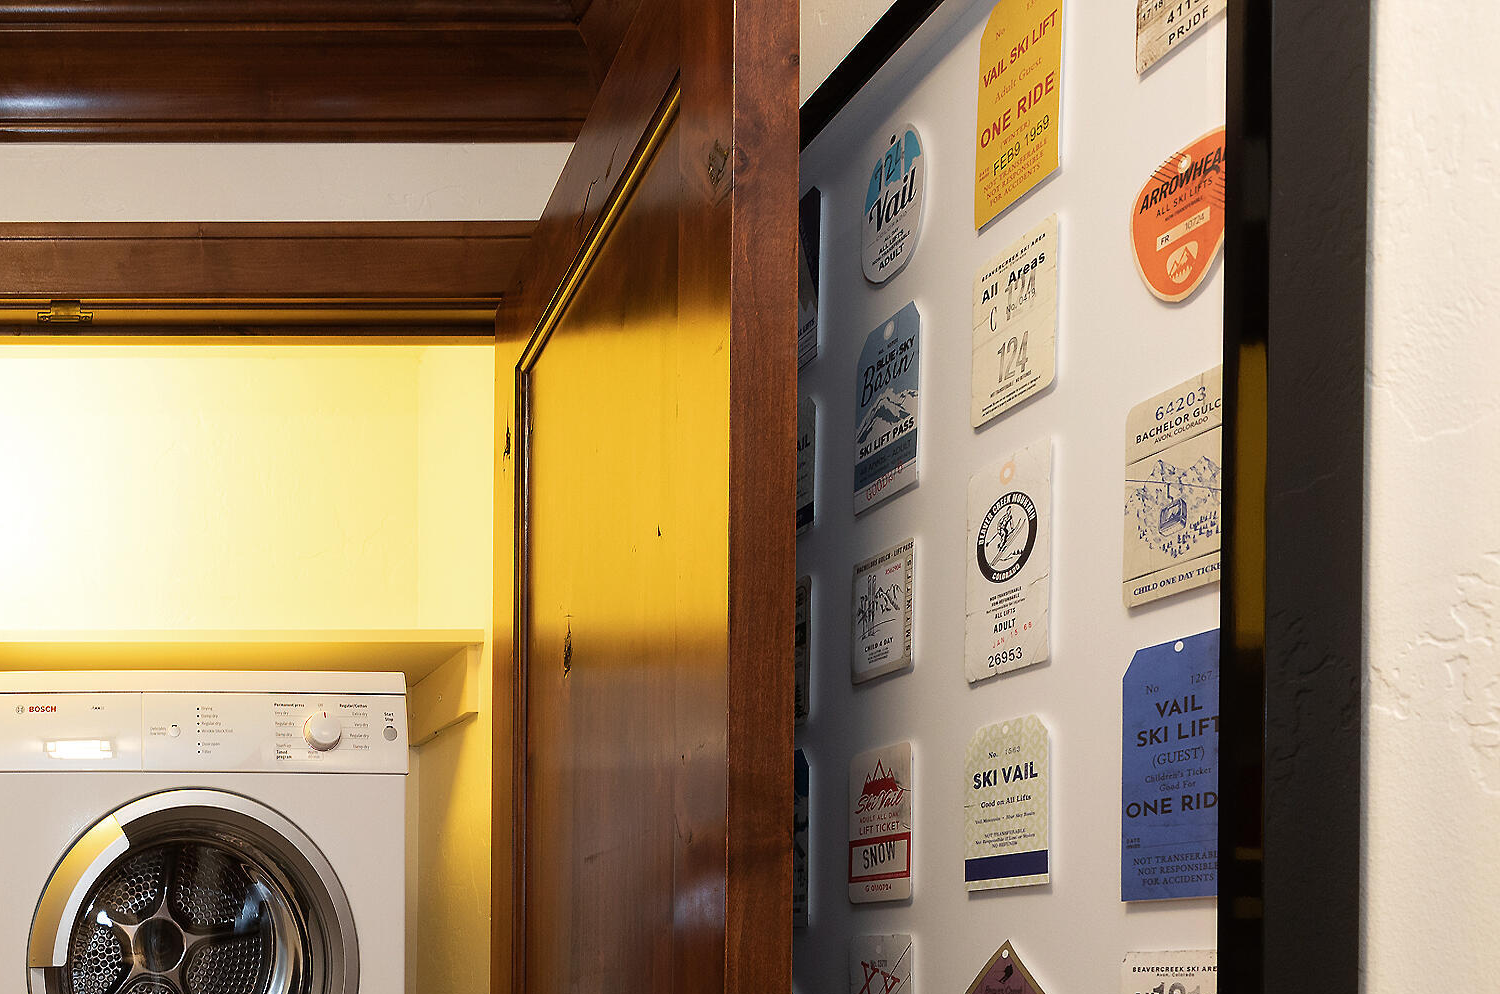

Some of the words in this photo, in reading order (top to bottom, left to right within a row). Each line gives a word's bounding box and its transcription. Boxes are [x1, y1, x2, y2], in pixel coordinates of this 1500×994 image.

[1142, 8, 1151, 21] 17
[1167, 0, 1200, 25] 411
[1168, 4, 1209, 45] PRJDF
[983, 58, 1008, 88] VAIL
[1010, 35, 1029, 64] SKI
[1032, 8, 1058, 46] LIFT
[994, 79, 1017, 104] Adult
[1018, 57, 1042, 81] Guest
[980, 108, 1012, 149] ONE
[1017, 70, 1055, 119] RIDE
[1025, 114, 1050, 146] 1959
[1139, 146, 1226, 215] ARROWHEA
[868, 166, 917, 233] Vail
[1156, 205, 1171, 218] ALL
[1173, 194, 1188, 208] SKI
[1189, 178, 1213, 199] LIFTS
[878, 243, 905, 272] ADULT
[981, 282, 999, 305] All
[1007, 252, 1046, 287] Areas
[876, 349, 897, 371] BLUE
[898, 334, 916, 357] SKY
[997, 330, 1029, 384] 124
[1155, 386, 1207, 421] 64203
[859, 441, 873, 460] SKI
[874, 430, 891, 450] LIFT
[892, 416, 915, 439] PASS
[1135, 412, 1190, 445] BACHELOR
[1173, 415, 1209, 436] COLORADO
[977, 512, 993, 547] BEAVER
[1133, 582, 1159, 597] CHILD
[1159, 576, 1177, 589] ONE
[1178, 569, 1196, 583] DAY
[993, 617, 1017, 634] ADULT
[884, 636, 894, 646] DAY
[987, 646, 1024, 669] 26953
[28, 705, 57, 713] BOSCH
[1155, 694, 1203, 719] VAIL
[1137, 726, 1169, 748] SKI
[1178, 715, 1220, 741] LIFT
[1152, 745, 1206, 769] (GUEST)
[973, 769, 999, 790] SKI
[1002, 761, 1038, 785] VAIL
[1145, 772, 1185, 784] Children's
[1187, 766, 1213, 778] Ticket
[1160, 781, 1181, 793] Good
[1183, 779, 1197, 789] For
[980, 799, 996, 809] Good
[997, 799, 1005, 807] on
[1006, 797, 1015, 805] All
[1017, 794, 1032, 804] Lifts
[1126, 797, 1178, 819] ONE
[859, 825, 874, 836] LIFT
[875, 820, 900, 833] TICKET
[862, 840, 896, 870] SNOW
[1133, 857, 1153, 867] NOT
[1139, 866, 1159, 876] NOT
[1143, 876, 1164, 886] FOR
[1167, 872, 1215, 885] ACCIDENTS
[1132, 966, 1185, 974] BEAVERCREEK
